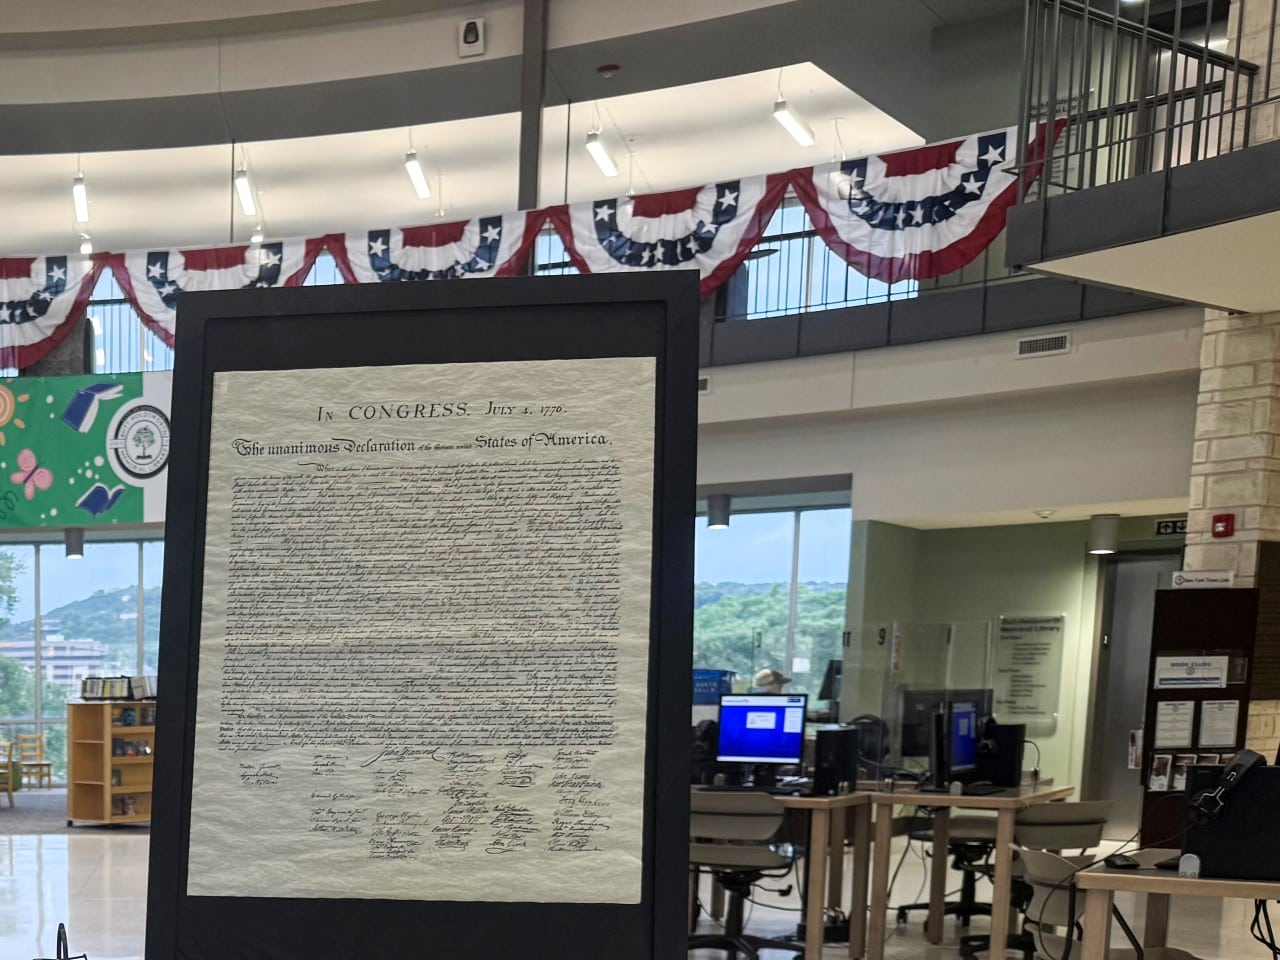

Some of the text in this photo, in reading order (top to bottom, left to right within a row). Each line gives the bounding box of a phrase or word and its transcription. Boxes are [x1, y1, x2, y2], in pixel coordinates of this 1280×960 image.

[268, 441, 340, 455] unanimous
[331, 437, 415, 453] Declaration
[474, 435, 518, 449] States
[521, 433, 535, 451] of
